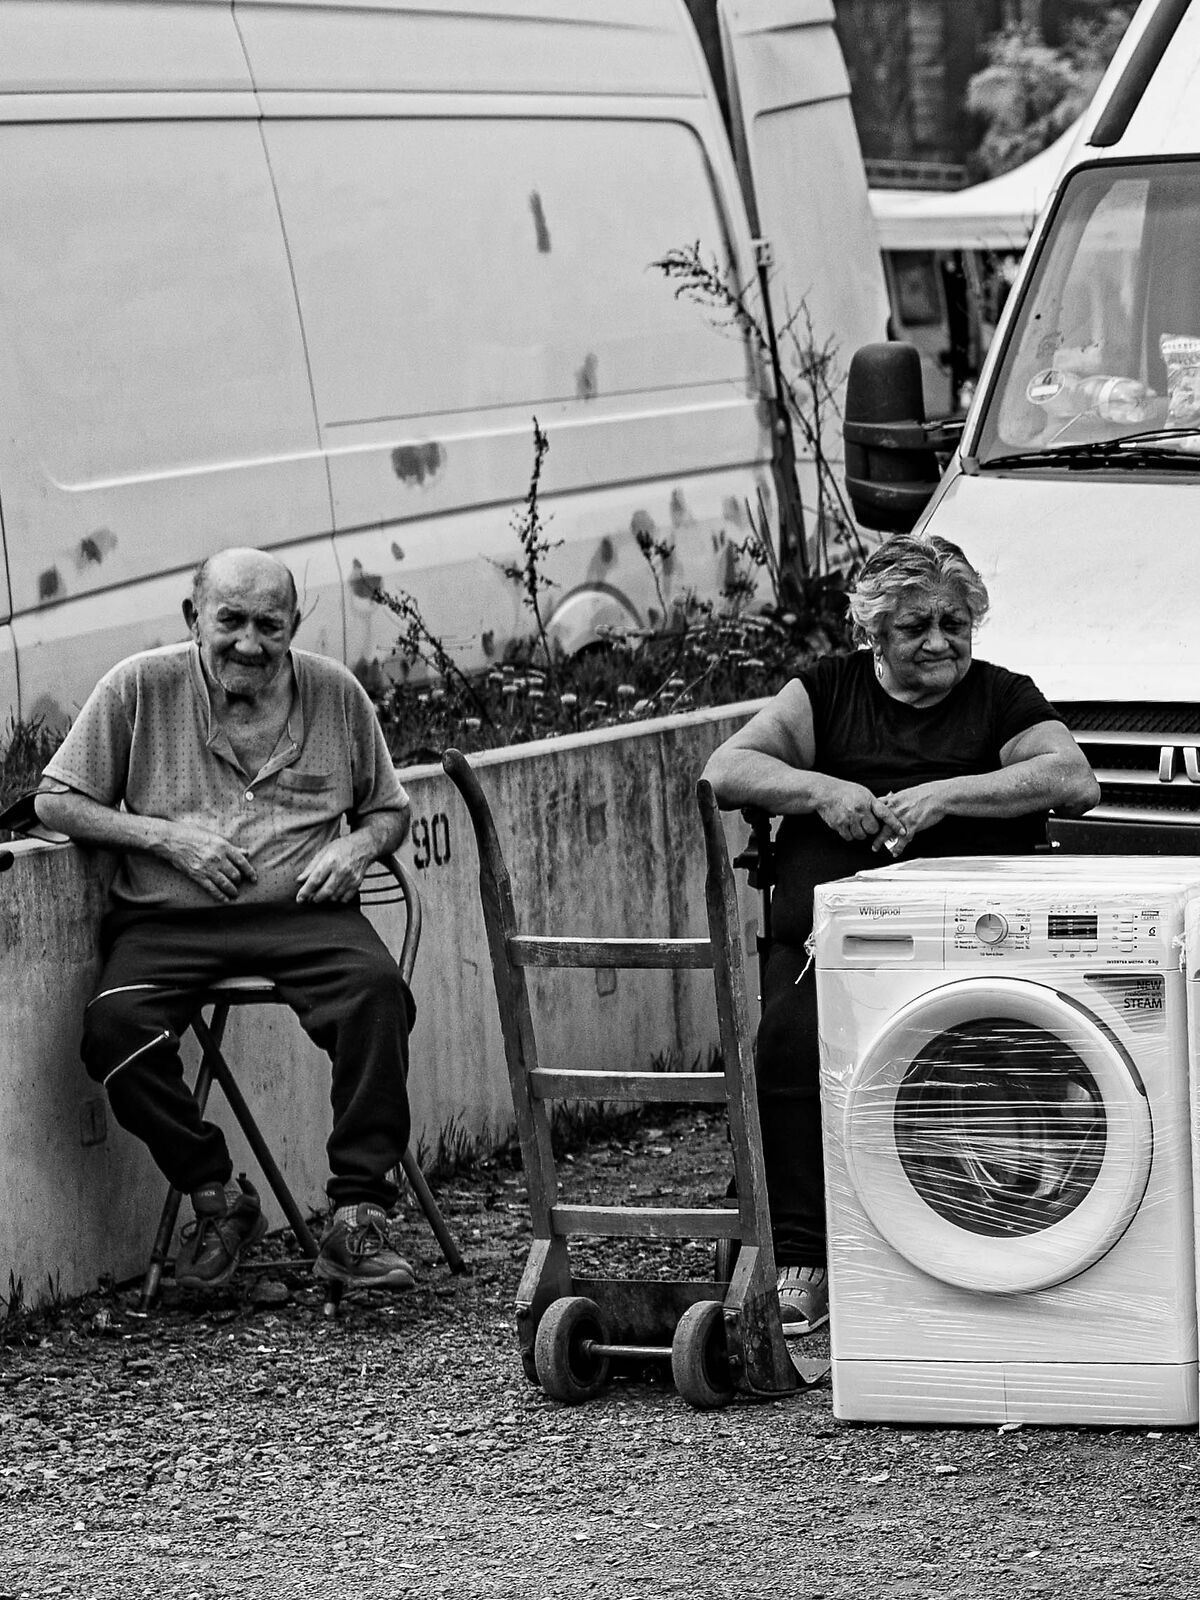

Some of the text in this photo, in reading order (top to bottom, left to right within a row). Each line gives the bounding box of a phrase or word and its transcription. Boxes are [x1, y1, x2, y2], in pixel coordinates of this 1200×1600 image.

[411, 813, 451, 870] 90
[859, 906, 901, 920] Whirlpool
[1136, 980, 1162, 991] NEW
[1123, 997, 1163, 1009] STEAM
